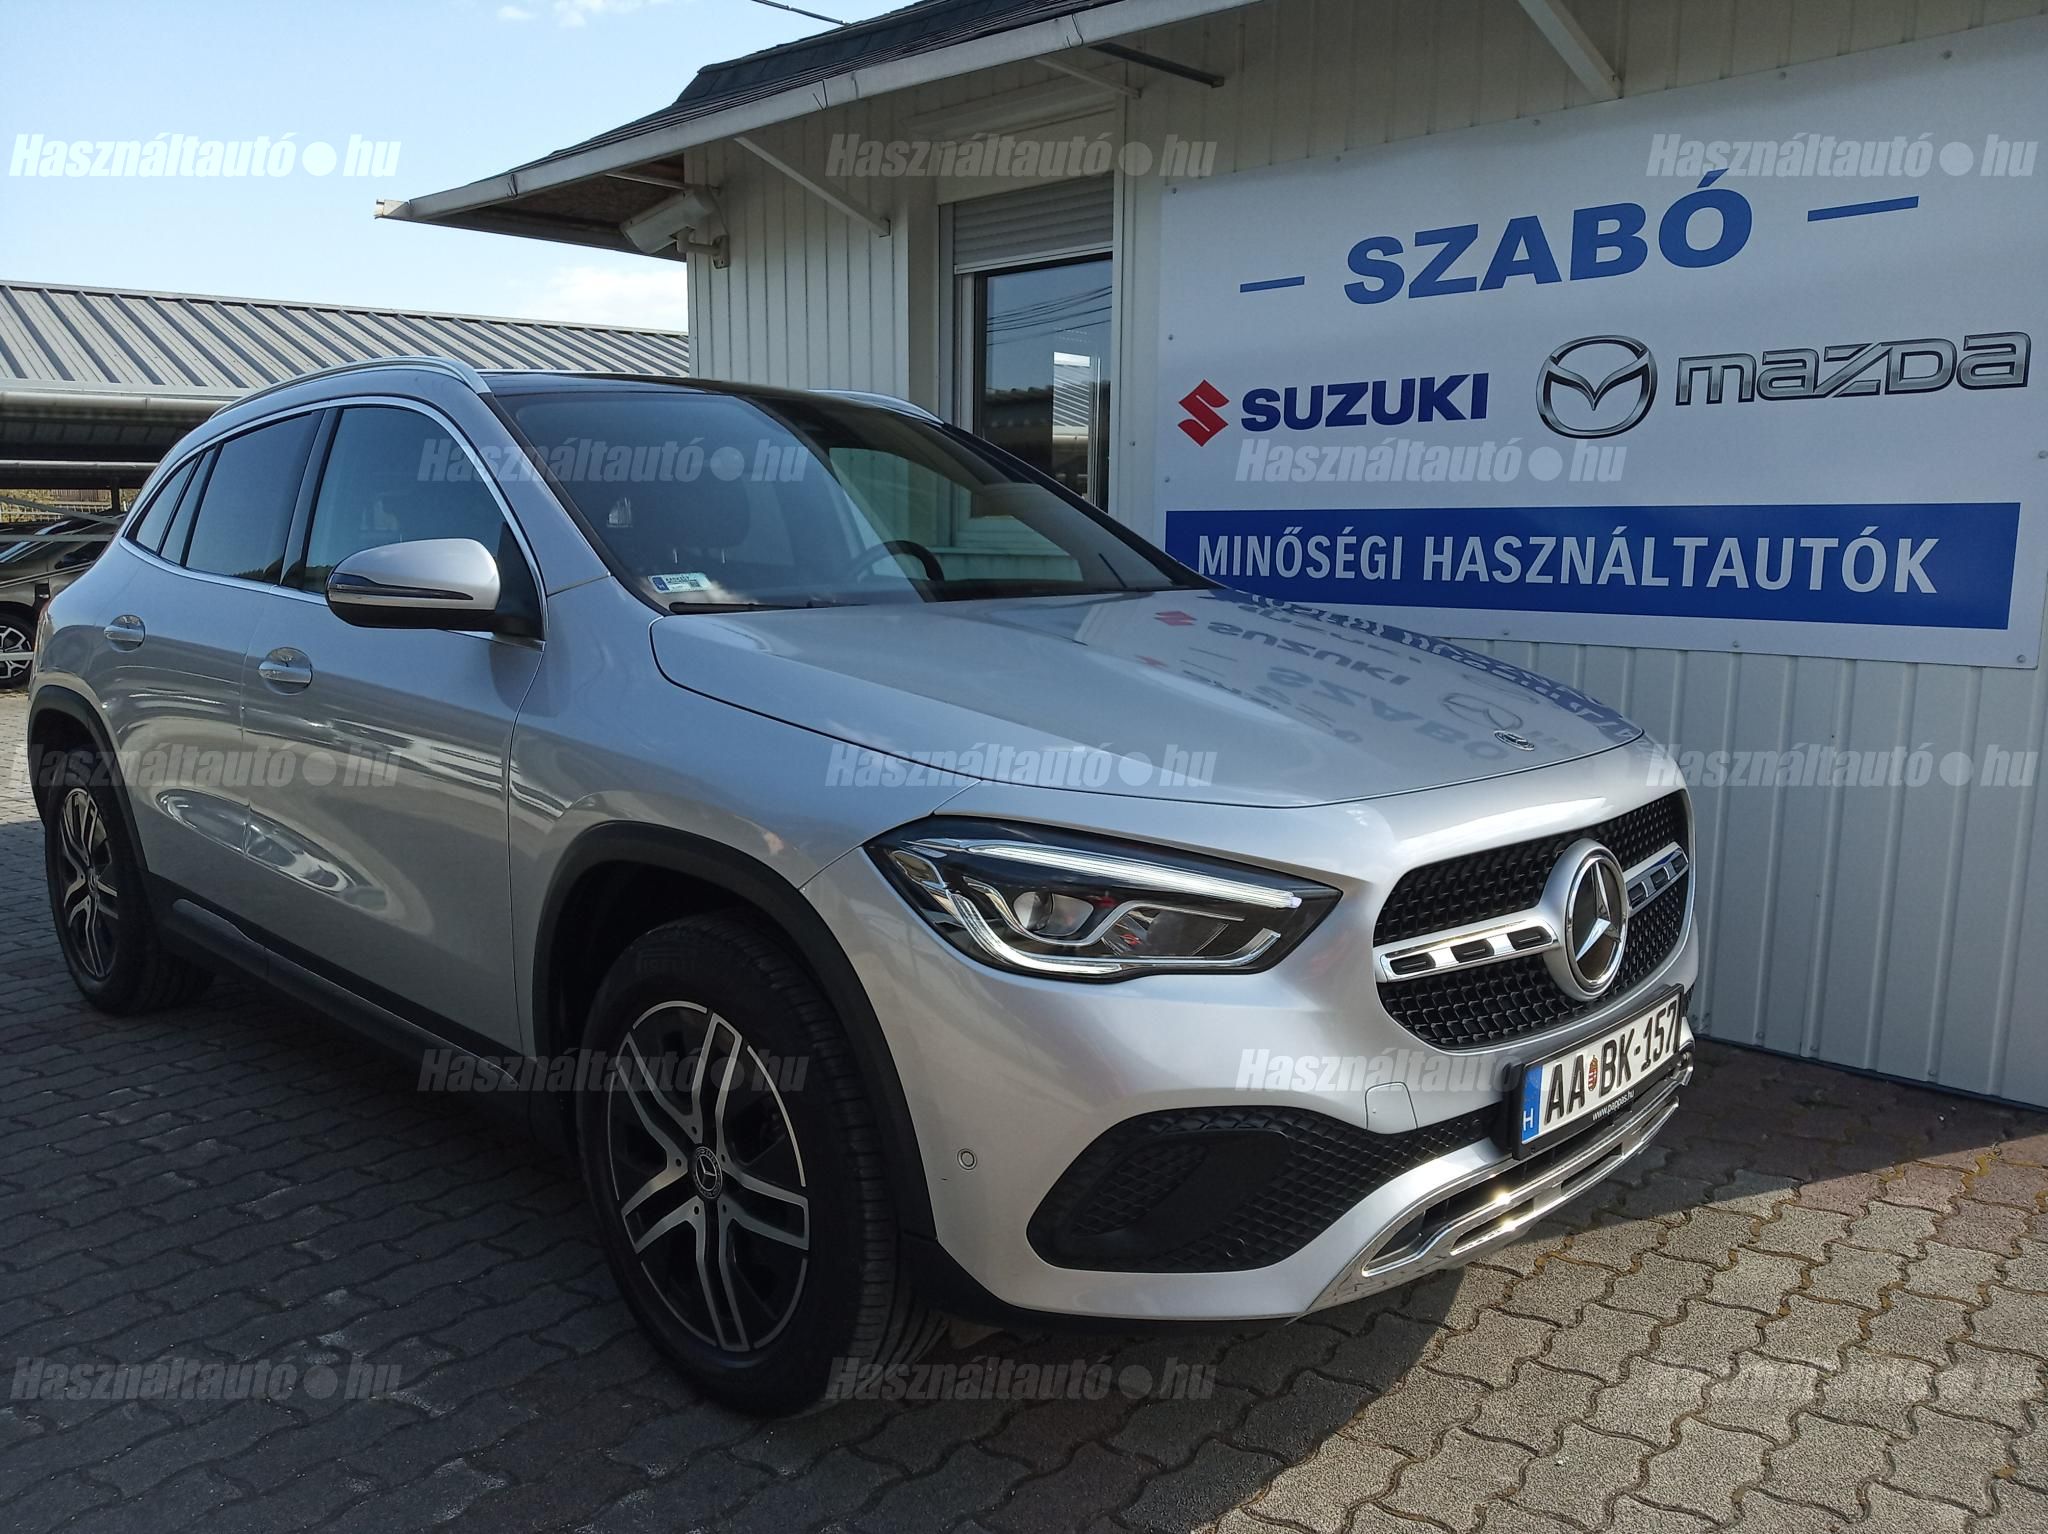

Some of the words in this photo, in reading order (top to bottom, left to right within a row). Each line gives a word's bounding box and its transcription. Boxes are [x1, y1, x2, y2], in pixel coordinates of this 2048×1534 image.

[1344, 168, 1752, 304] SZABÓ
[1241, 373, 1489, 431] SUZUKI
[1199, 527, 1402, 580] MINŐSÉGI
[1423, 526, 1939, 593] HASZNÁLTAUTÓK
[1523, 1108, 1534, 1131] H
